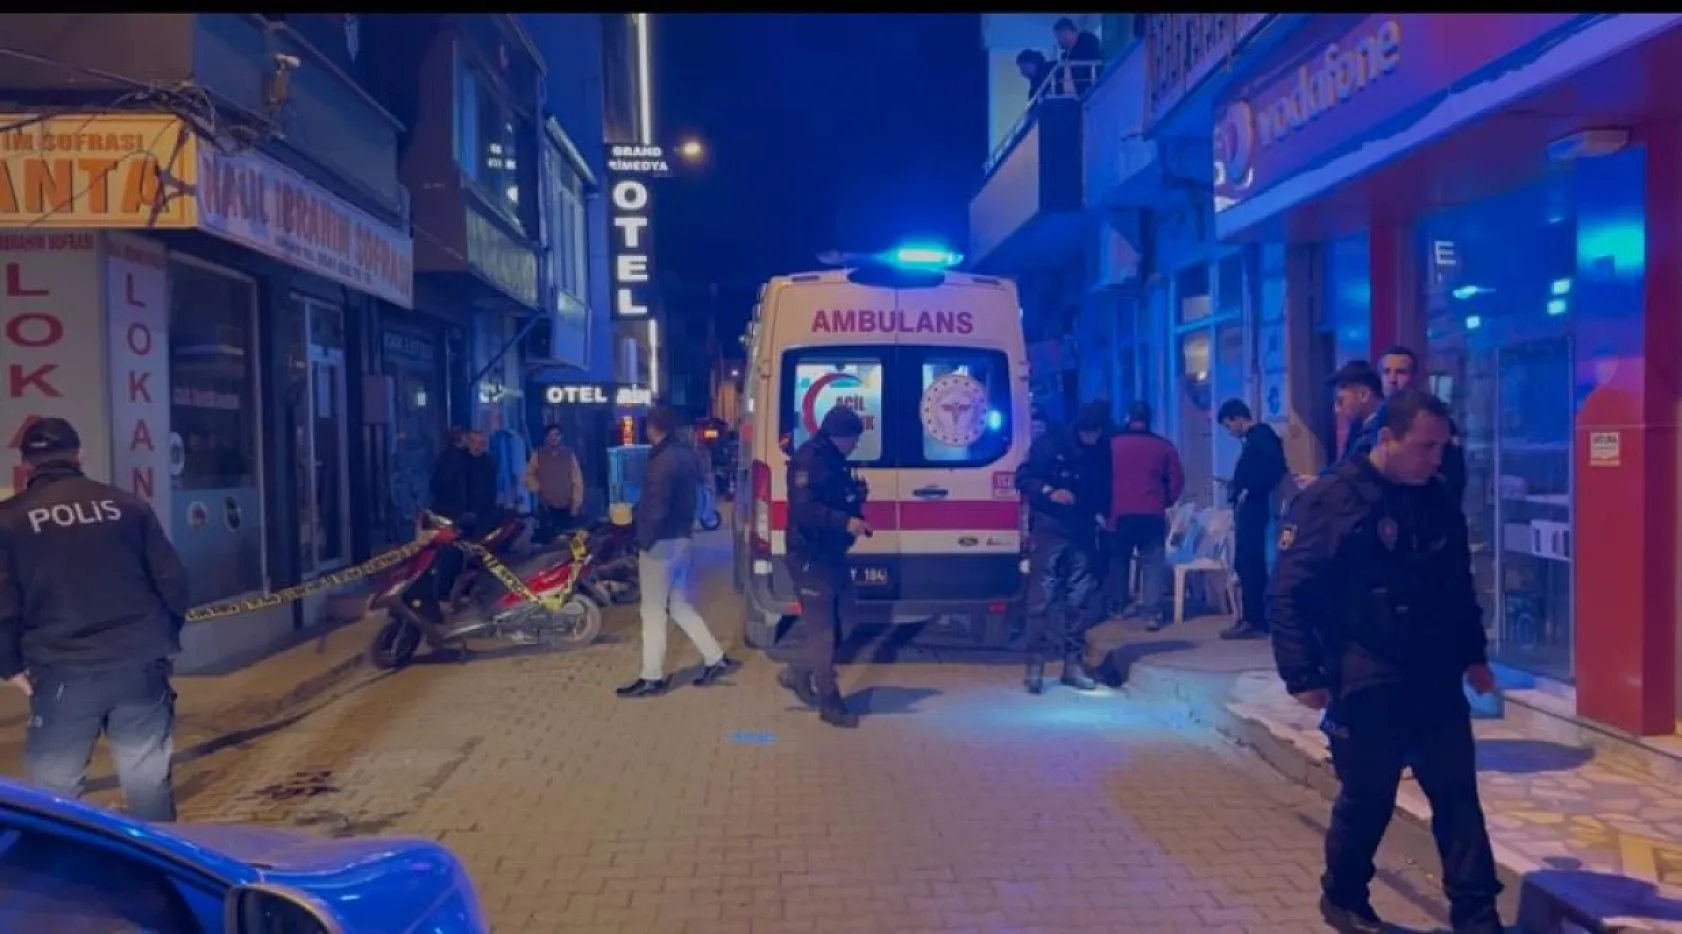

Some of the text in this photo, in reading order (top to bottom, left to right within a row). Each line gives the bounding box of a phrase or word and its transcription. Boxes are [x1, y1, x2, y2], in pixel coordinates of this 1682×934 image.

[612, 180, 649, 316] OTEL
[811, 310, 974, 334] AMBULANS
[546, 386, 608, 404] OTEL
